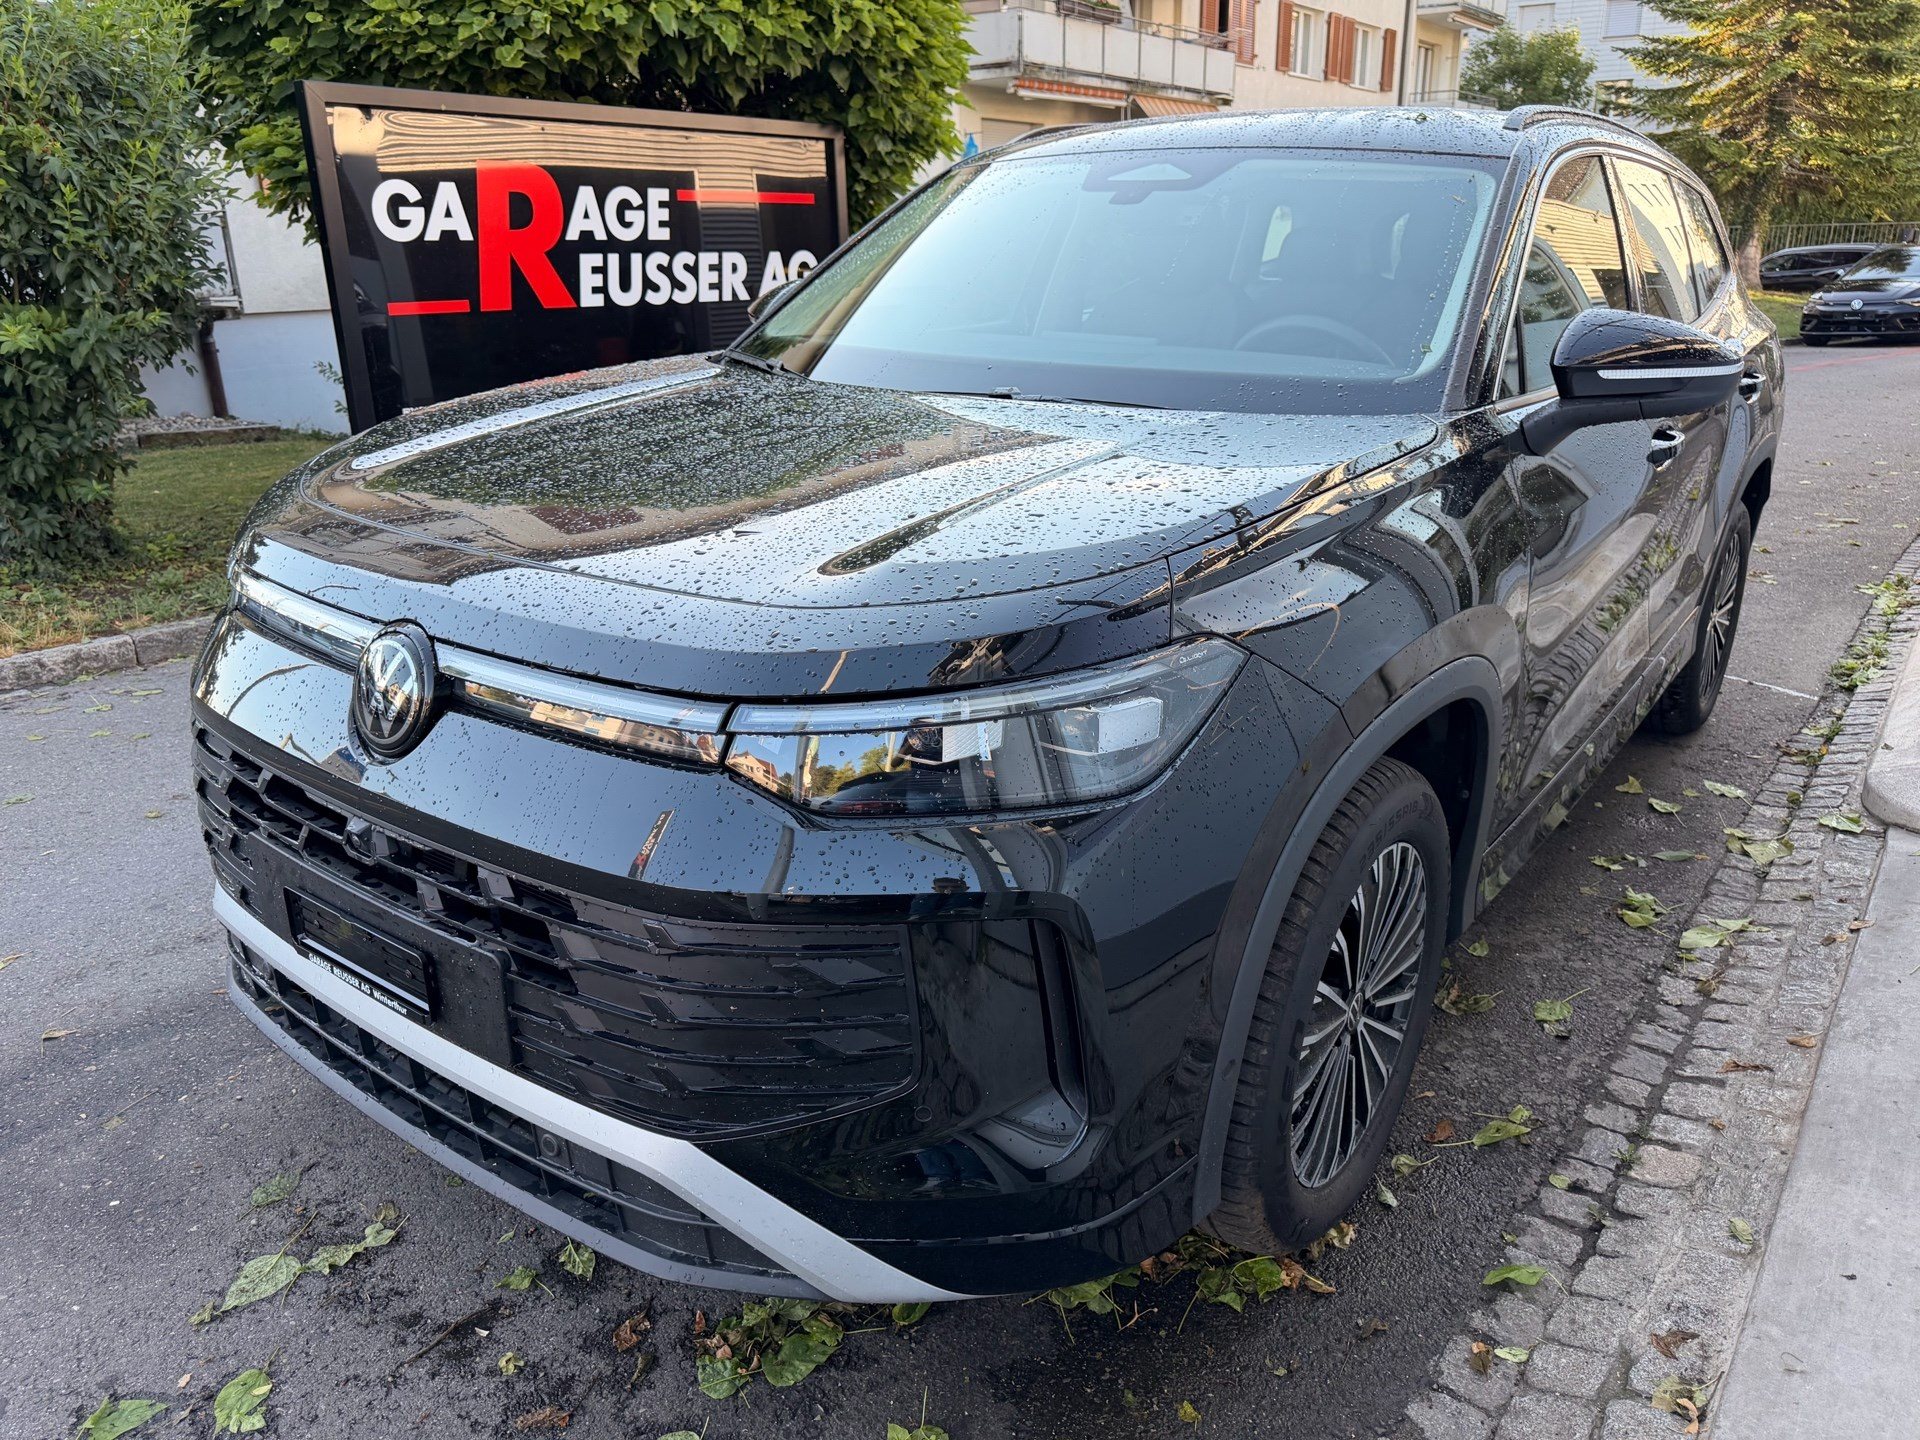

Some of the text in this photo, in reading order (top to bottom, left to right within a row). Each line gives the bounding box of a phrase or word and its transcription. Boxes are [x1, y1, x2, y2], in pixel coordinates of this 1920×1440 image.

[371, 159, 671, 312] GARAGE
[308, 953, 408, 1016] GARAGE REUSSER AG Winterthur
